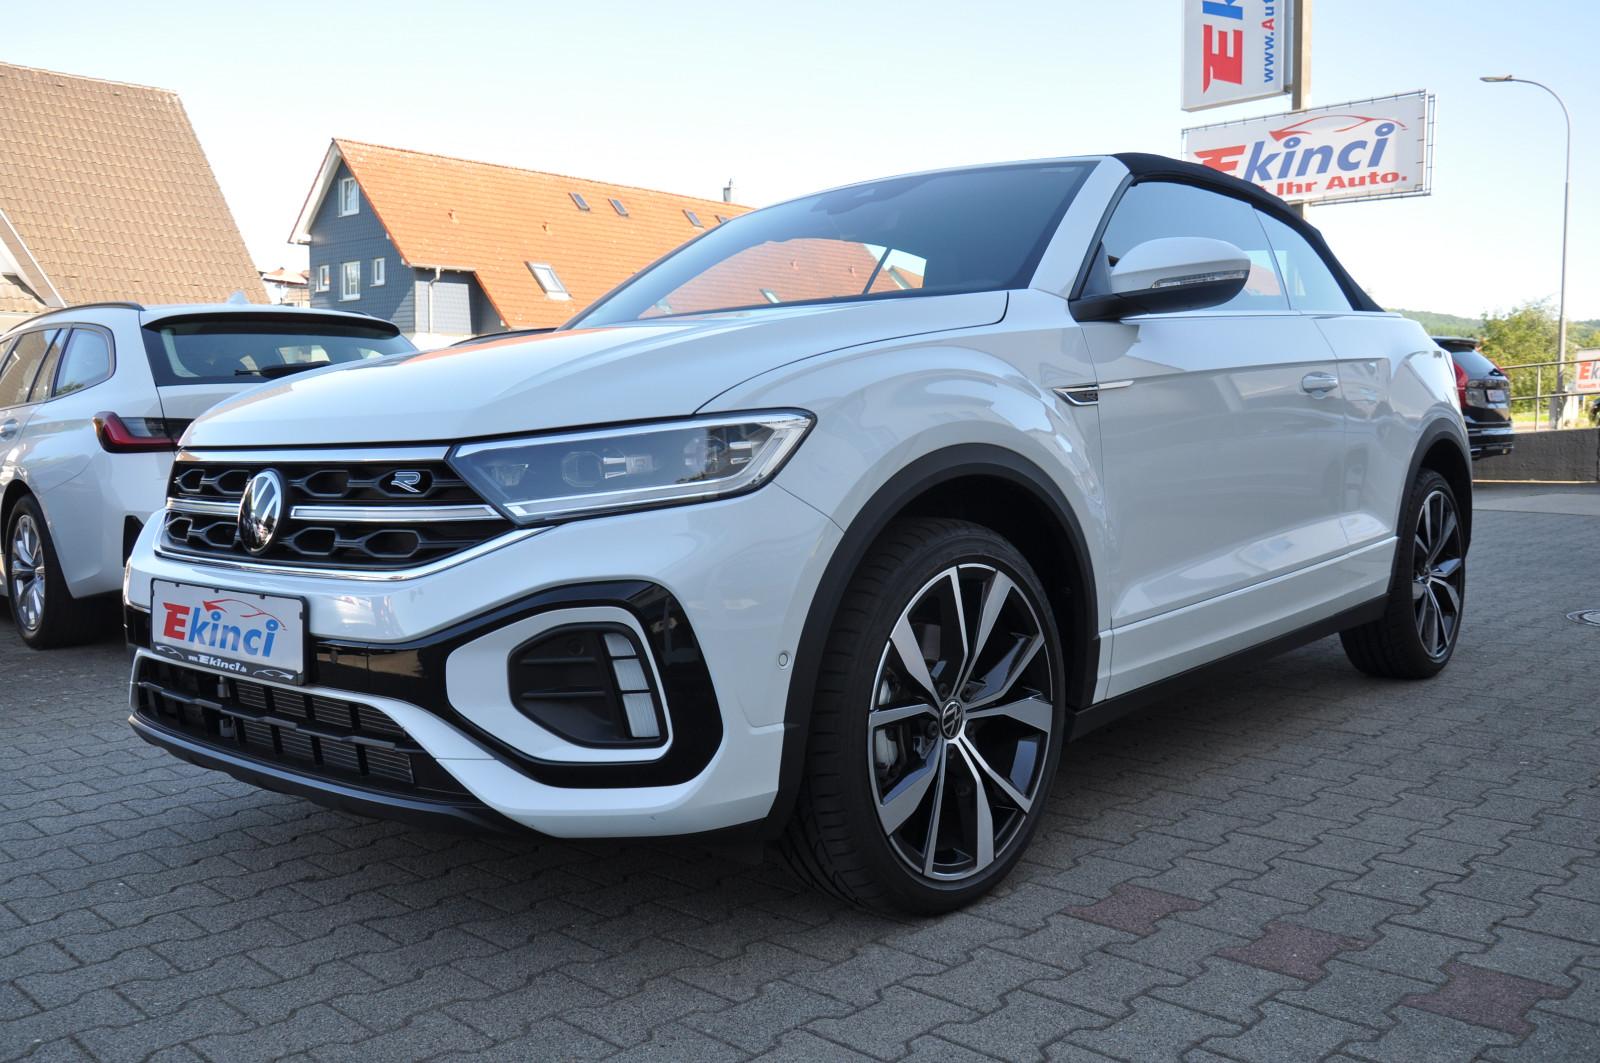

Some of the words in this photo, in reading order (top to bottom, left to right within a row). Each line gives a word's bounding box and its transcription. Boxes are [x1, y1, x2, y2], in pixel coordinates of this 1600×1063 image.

[1277, 181, 1318, 196] Ihr
[1326, 171, 1408, 190] Auto.
[163, 602, 279, 657] Ekinci
